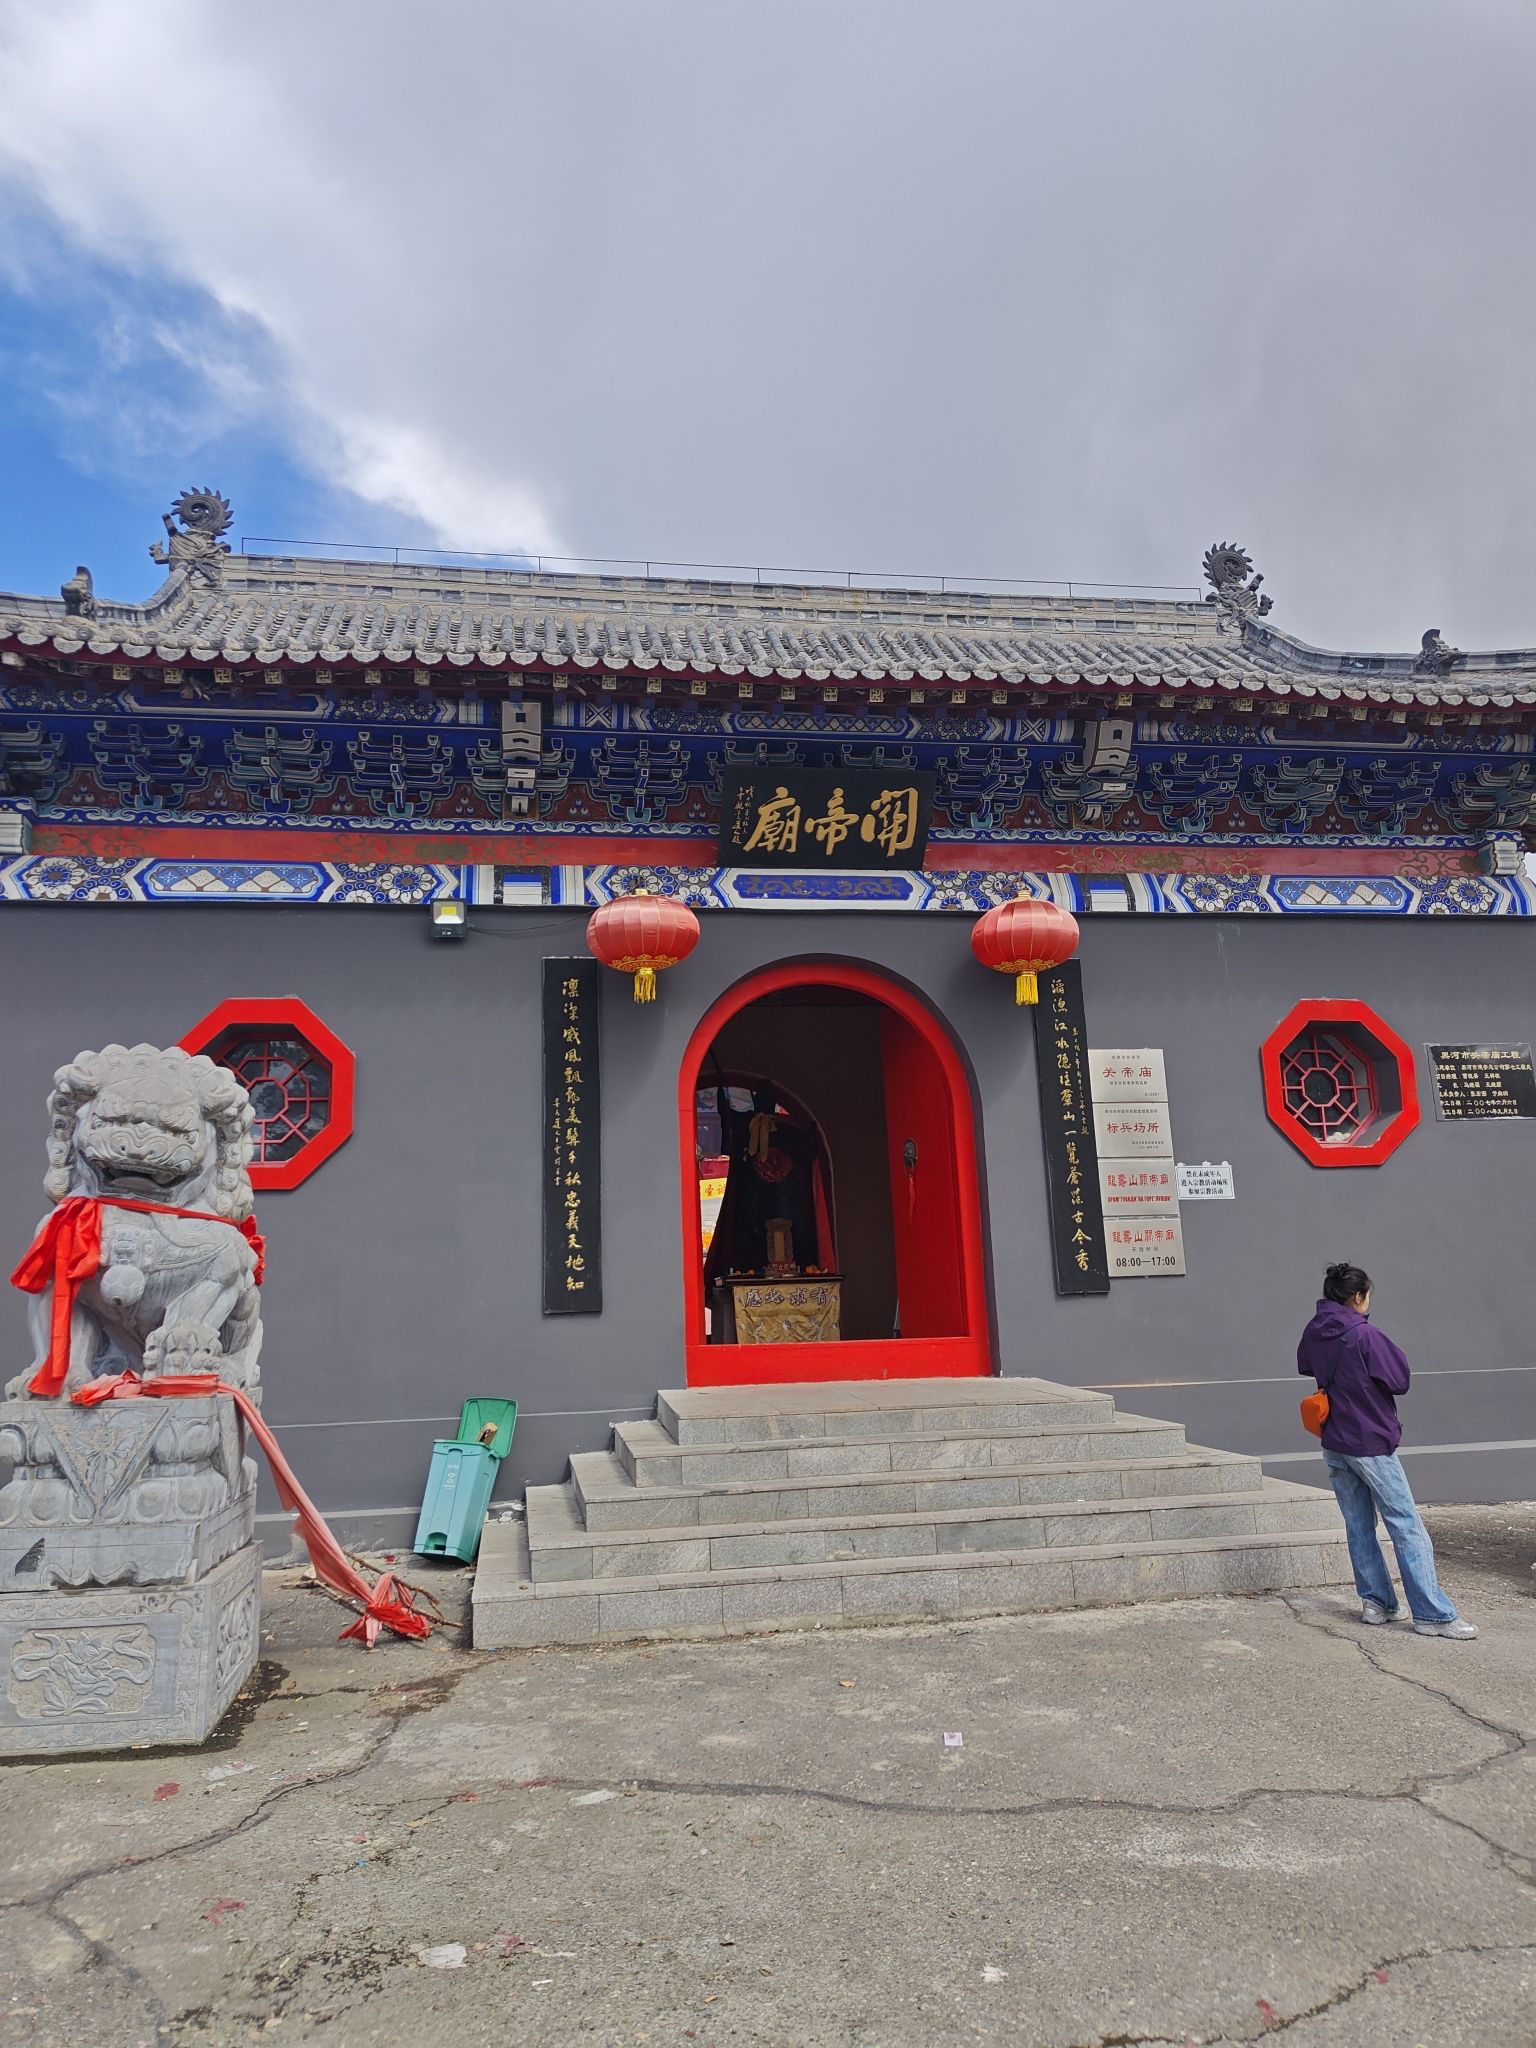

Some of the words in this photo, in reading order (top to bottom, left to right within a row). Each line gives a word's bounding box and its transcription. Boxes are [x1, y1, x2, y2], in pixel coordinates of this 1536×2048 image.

[1440, 1051, 1521, 1060] 黑河市关帝庙工程
[1103, 1067, 1152, 1078] 关帝庙
[1107, 1122, 1160, 1134] 标兵场所
[1186, 1170, 1222, 1178] 禁止未成年人
[1181, 1179, 1229, 1187] 进入宗教活动场所
[1188, 1187, 1224, 1195] 参加宗教活动
